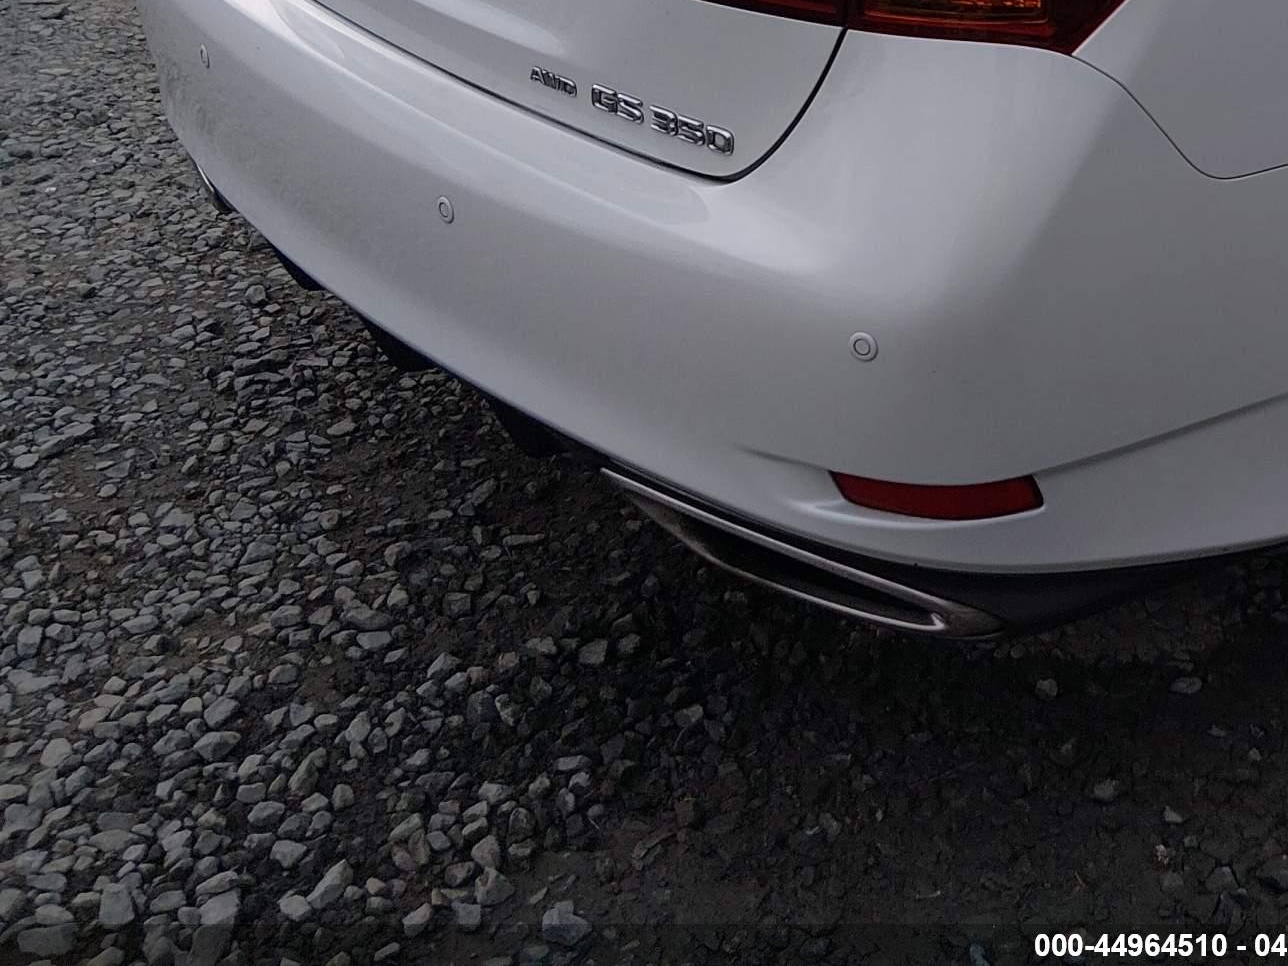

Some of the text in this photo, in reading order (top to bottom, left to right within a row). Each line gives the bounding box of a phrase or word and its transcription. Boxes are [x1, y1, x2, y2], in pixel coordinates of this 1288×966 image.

[530, 65, 577, 97] AWD
[591, 83, 735, 156] GS 350
